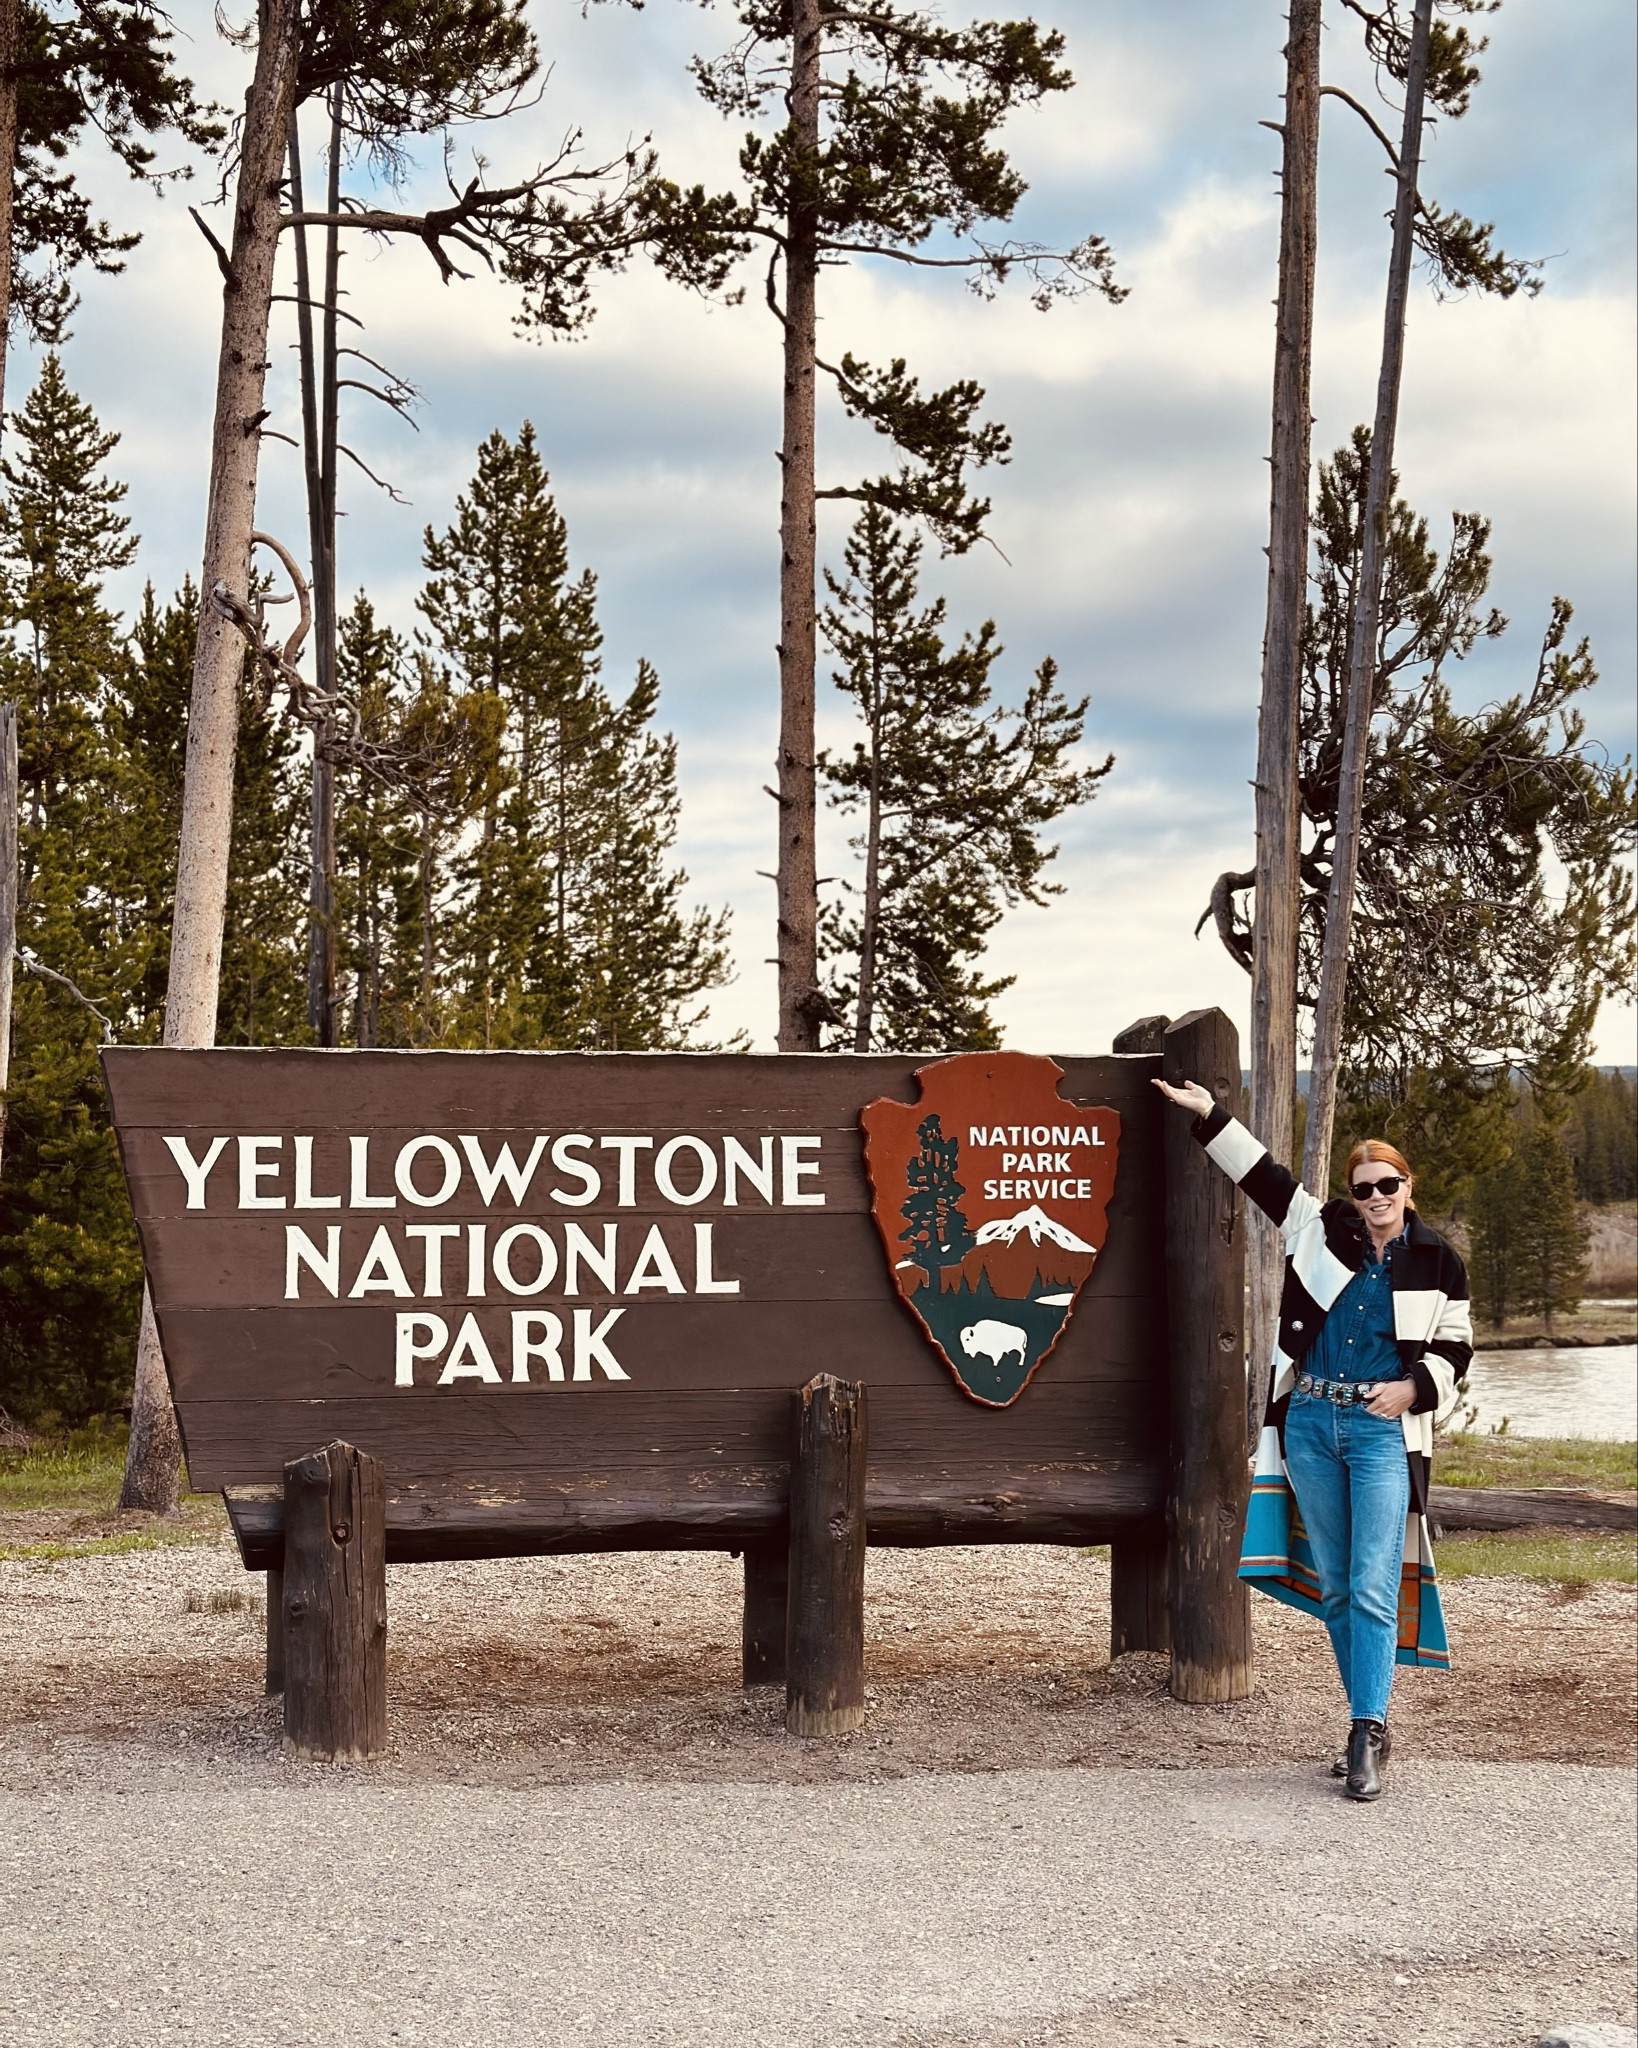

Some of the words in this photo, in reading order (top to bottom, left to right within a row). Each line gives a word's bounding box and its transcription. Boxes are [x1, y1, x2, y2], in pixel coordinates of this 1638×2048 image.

[969, 1125, 1105, 1147] NATIONAL
[161, 1134, 826, 1210] YELLOWSTONE
[1002, 1152, 1072, 1173] PARK
[983, 1178, 1092, 1200] SERVICE
[284, 1223, 740, 1300] NATIONAL
[394, 1308, 632, 1388] PARK
